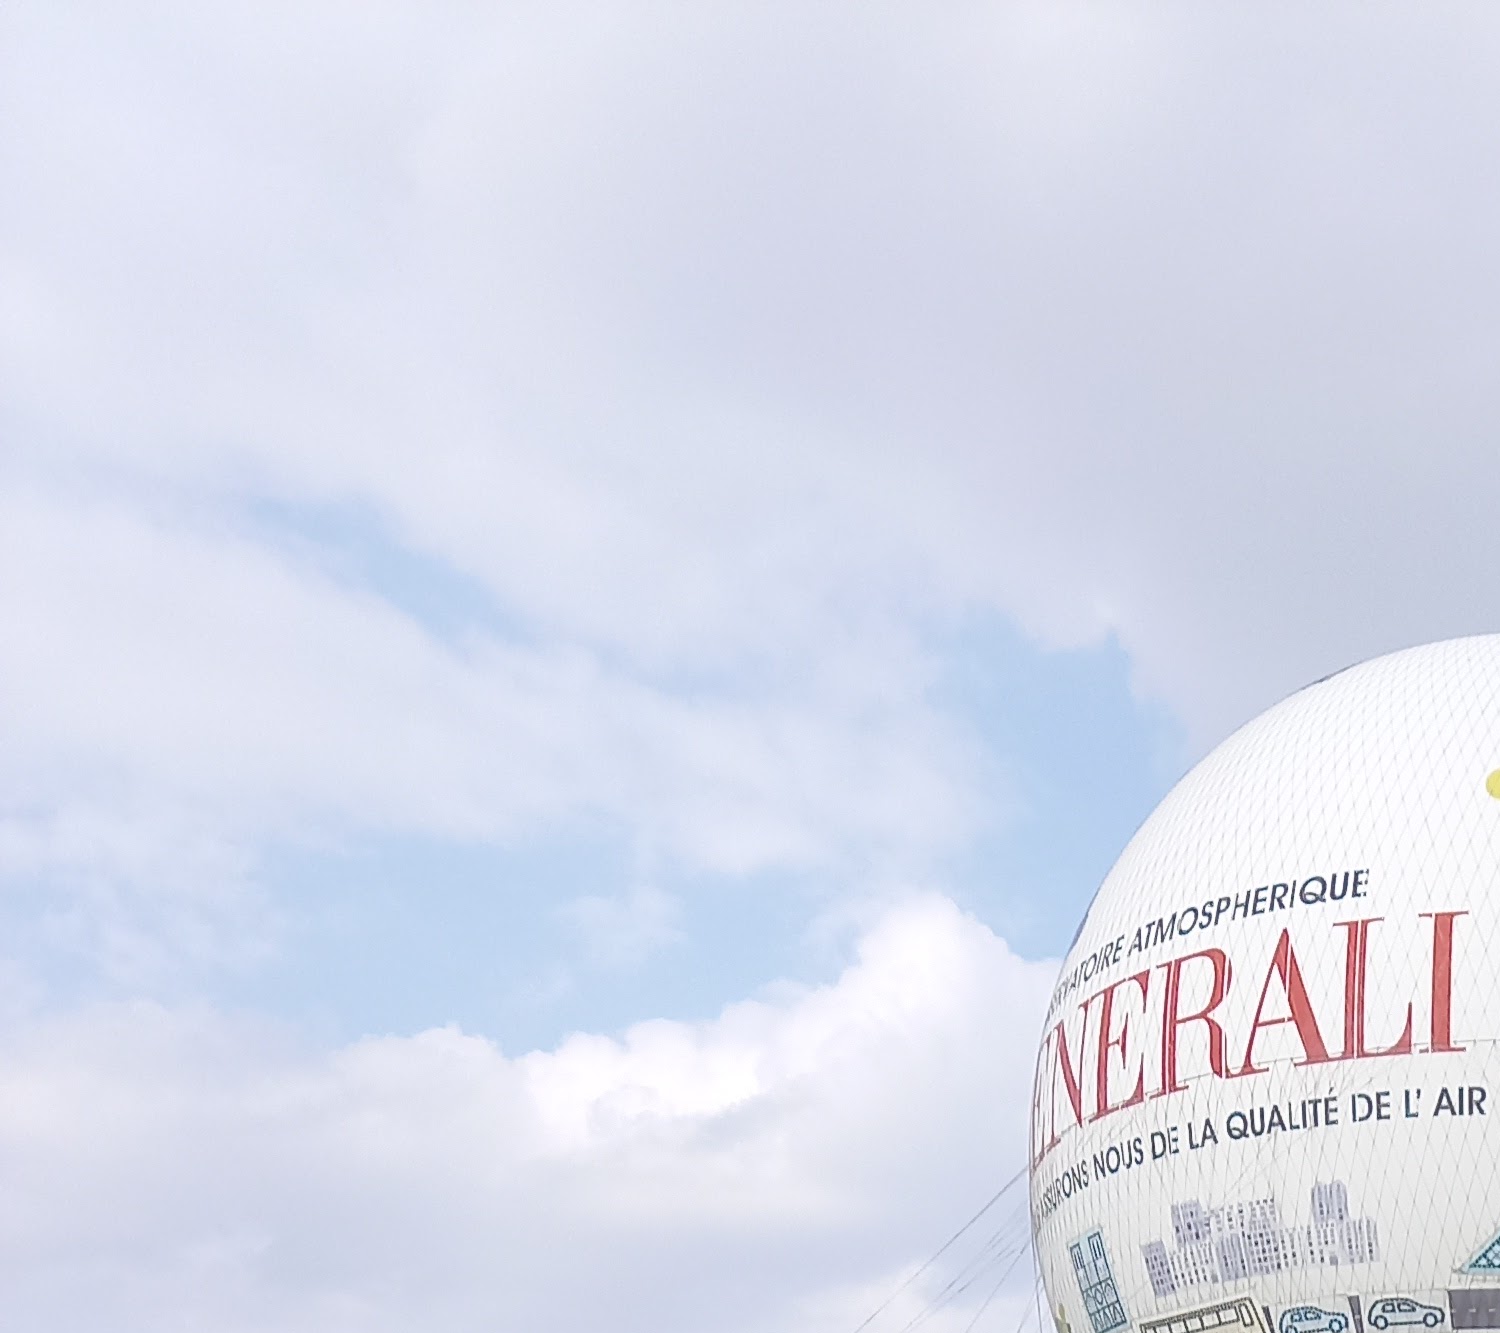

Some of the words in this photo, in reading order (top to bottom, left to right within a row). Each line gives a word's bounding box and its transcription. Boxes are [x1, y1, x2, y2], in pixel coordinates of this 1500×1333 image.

[1127, 868, 1370, 957] ATMOSPHERIQUE
[1093, 1137, 1144, 1181] NOUS
[1151, 1126, 1179, 1160] DE
[1188, 1118, 1218, 1149] LA
[1226, 1087, 1339, 1141] QUALITÉ
[1351, 1091, 1391, 1123] DE
[1432, 1085, 1487, 1118] AIR
